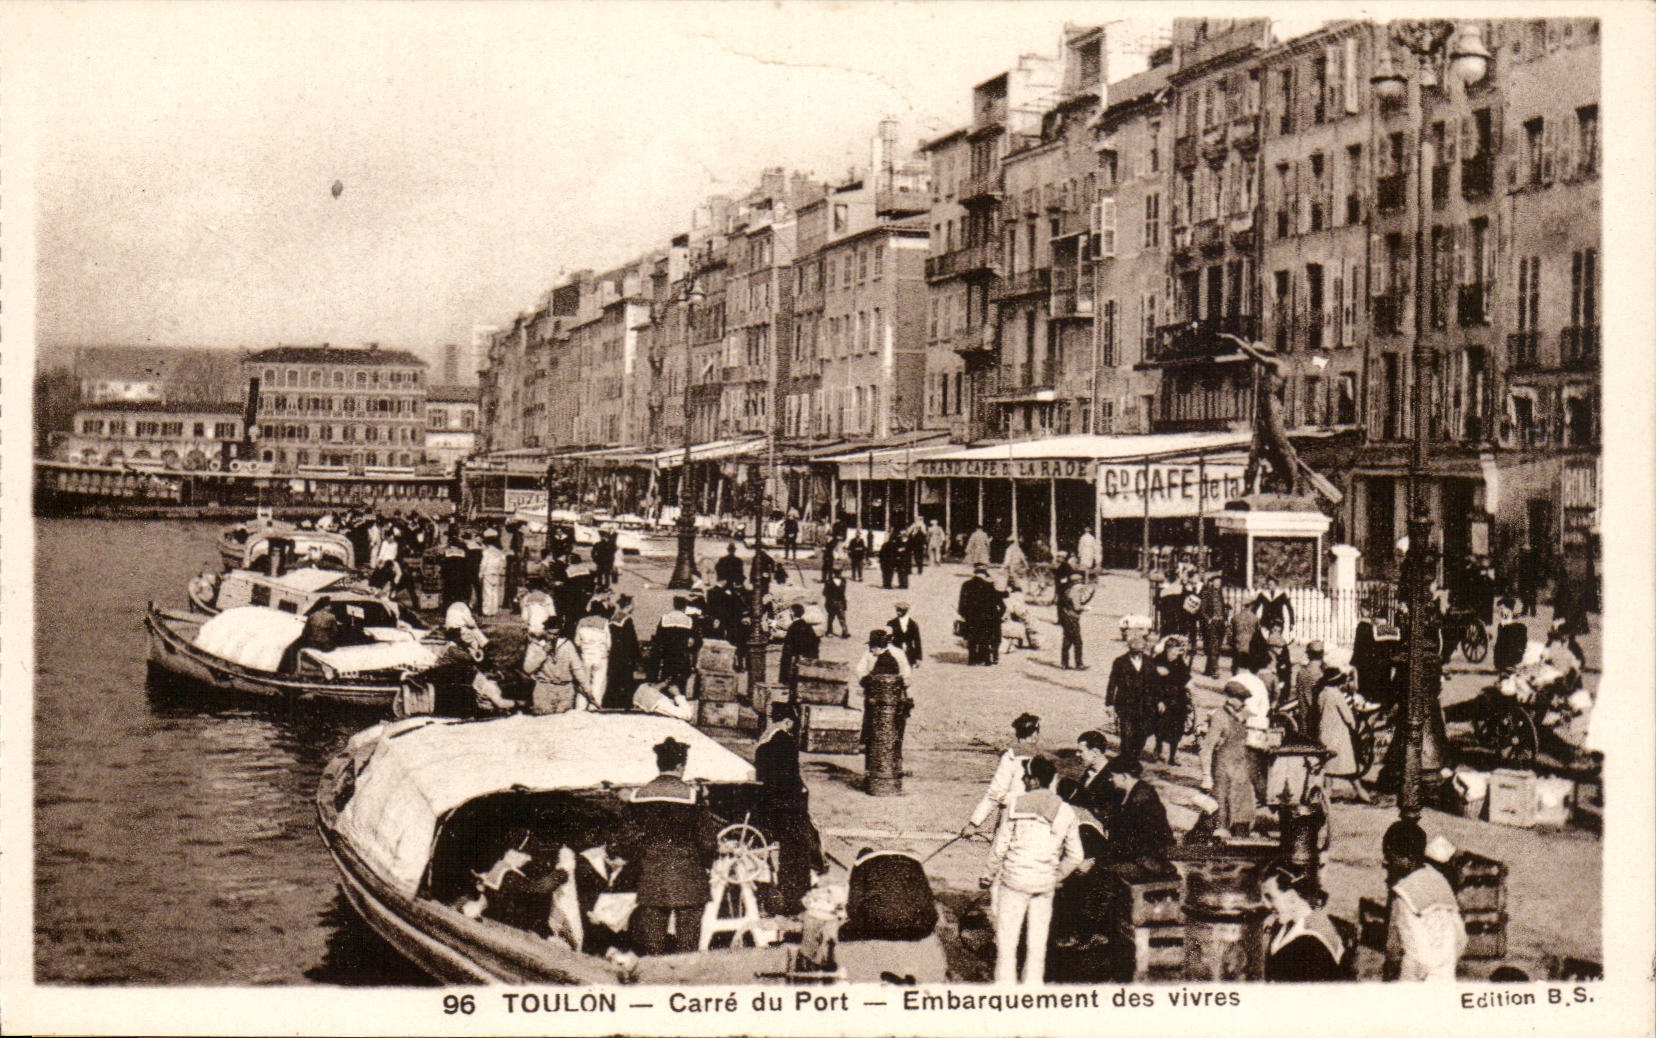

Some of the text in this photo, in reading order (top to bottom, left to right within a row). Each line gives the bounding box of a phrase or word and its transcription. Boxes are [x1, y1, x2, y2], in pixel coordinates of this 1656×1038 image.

[921, 461, 961, 475] GRAND
[1020, 462, 1035, 475] LA
[1041, 461, 1087, 476] RADE
[1135, 468, 1194, 499] CAFE
[1224, 472, 1239, 499] la
